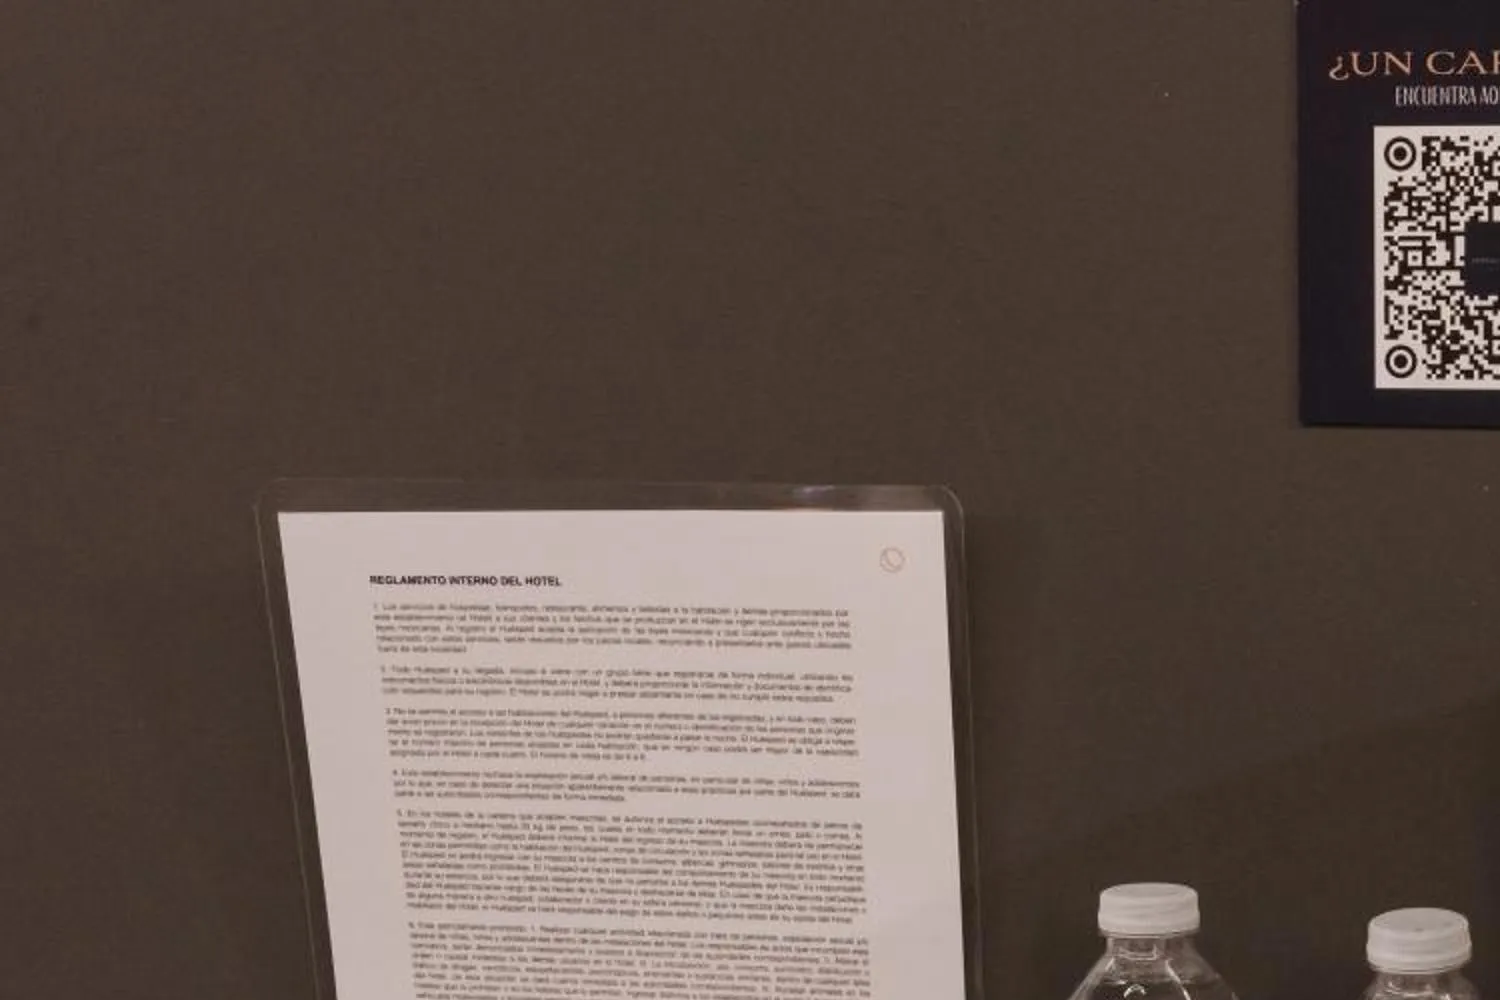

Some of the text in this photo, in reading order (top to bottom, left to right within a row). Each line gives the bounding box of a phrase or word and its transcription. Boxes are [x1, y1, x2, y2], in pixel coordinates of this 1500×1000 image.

[1328, 50, 1415, 81] ¿UN
[1394, 84, 1477, 106] ENCUENTRA
[369, 574, 563, 588] REGLAMENTO INTERNO DEL HOTEL
